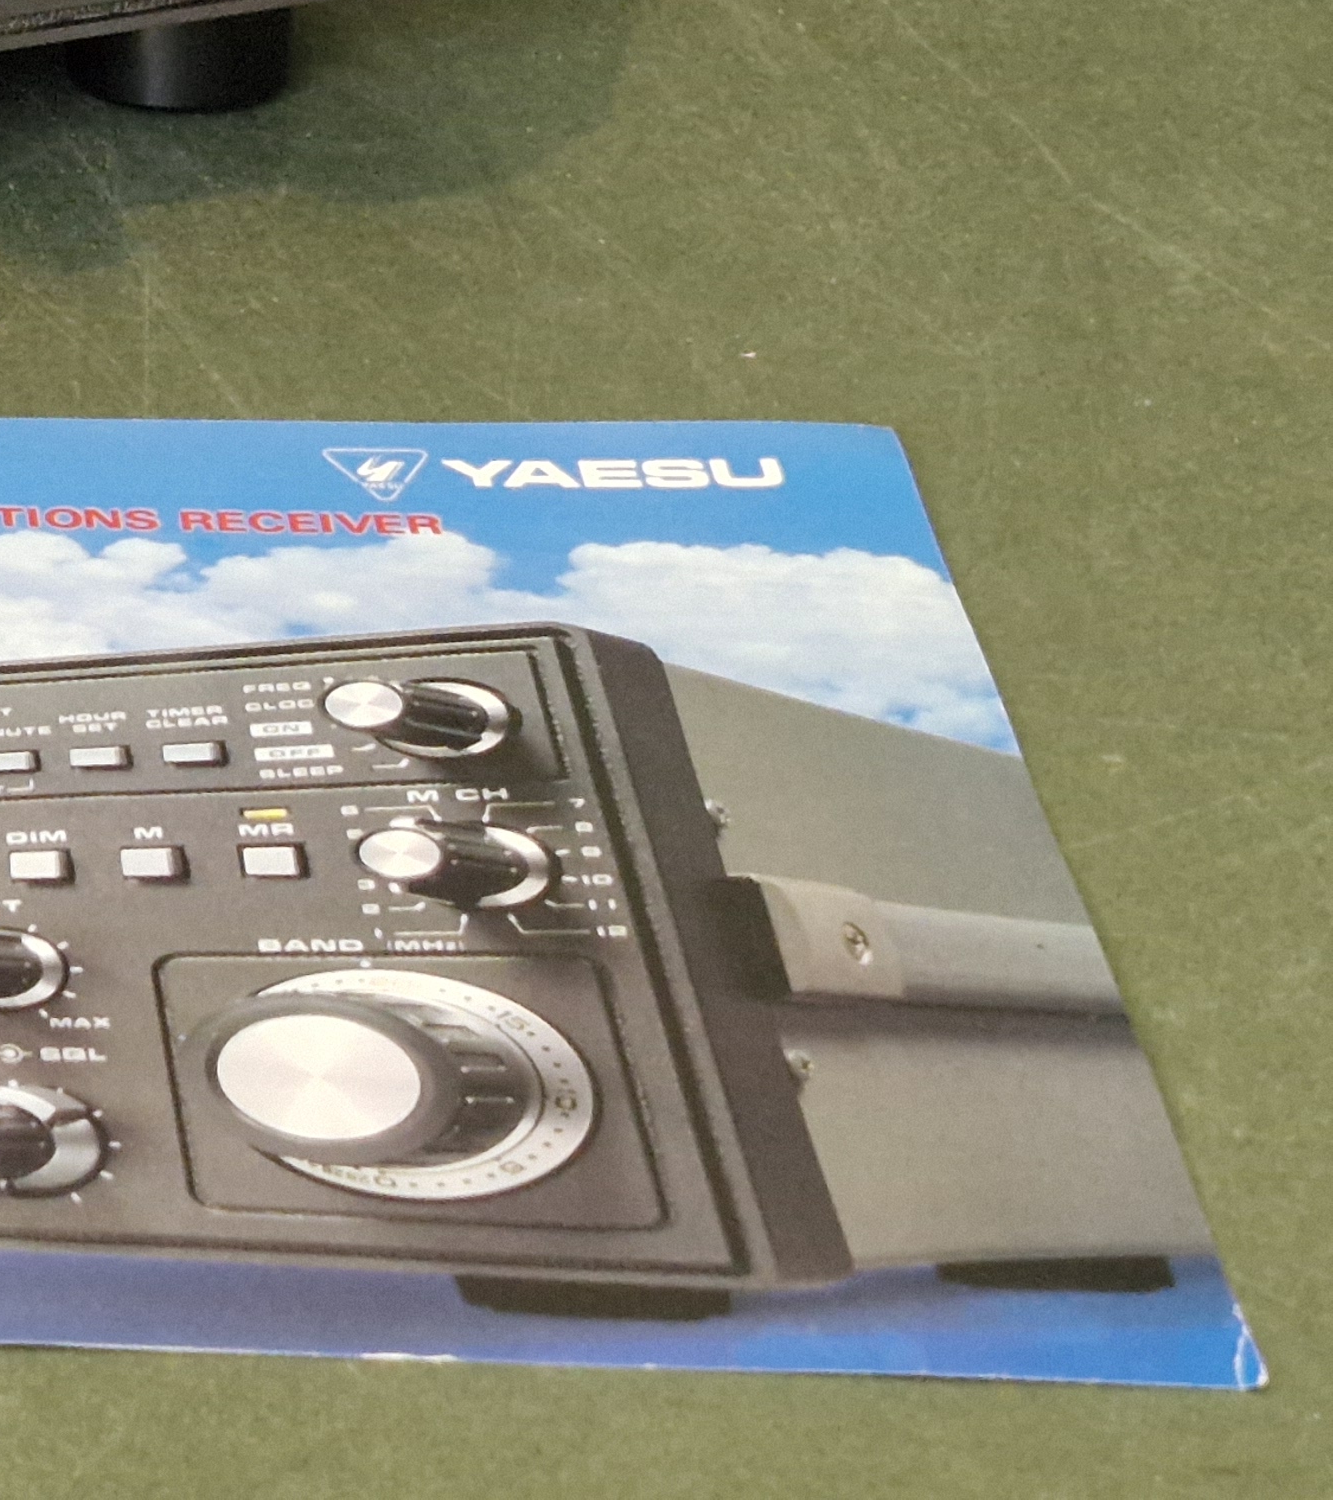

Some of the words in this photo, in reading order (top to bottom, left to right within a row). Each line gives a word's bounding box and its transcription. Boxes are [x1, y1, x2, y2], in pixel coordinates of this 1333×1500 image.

[441, 457, 783, 489] YAESU
[179, 508, 442, 537] RECEIVER
[59, 711, 127, 724] HOUR
[407, 789, 439, 803] M
[455, 788, 509, 801] CH
[5, 828, 68, 845] DIM
[135, 825, 164, 839] M
[238, 821, 293, 837] MR
[258, 938, 364, 952] BAND
[50, 1015, 110, 1029] MAX
